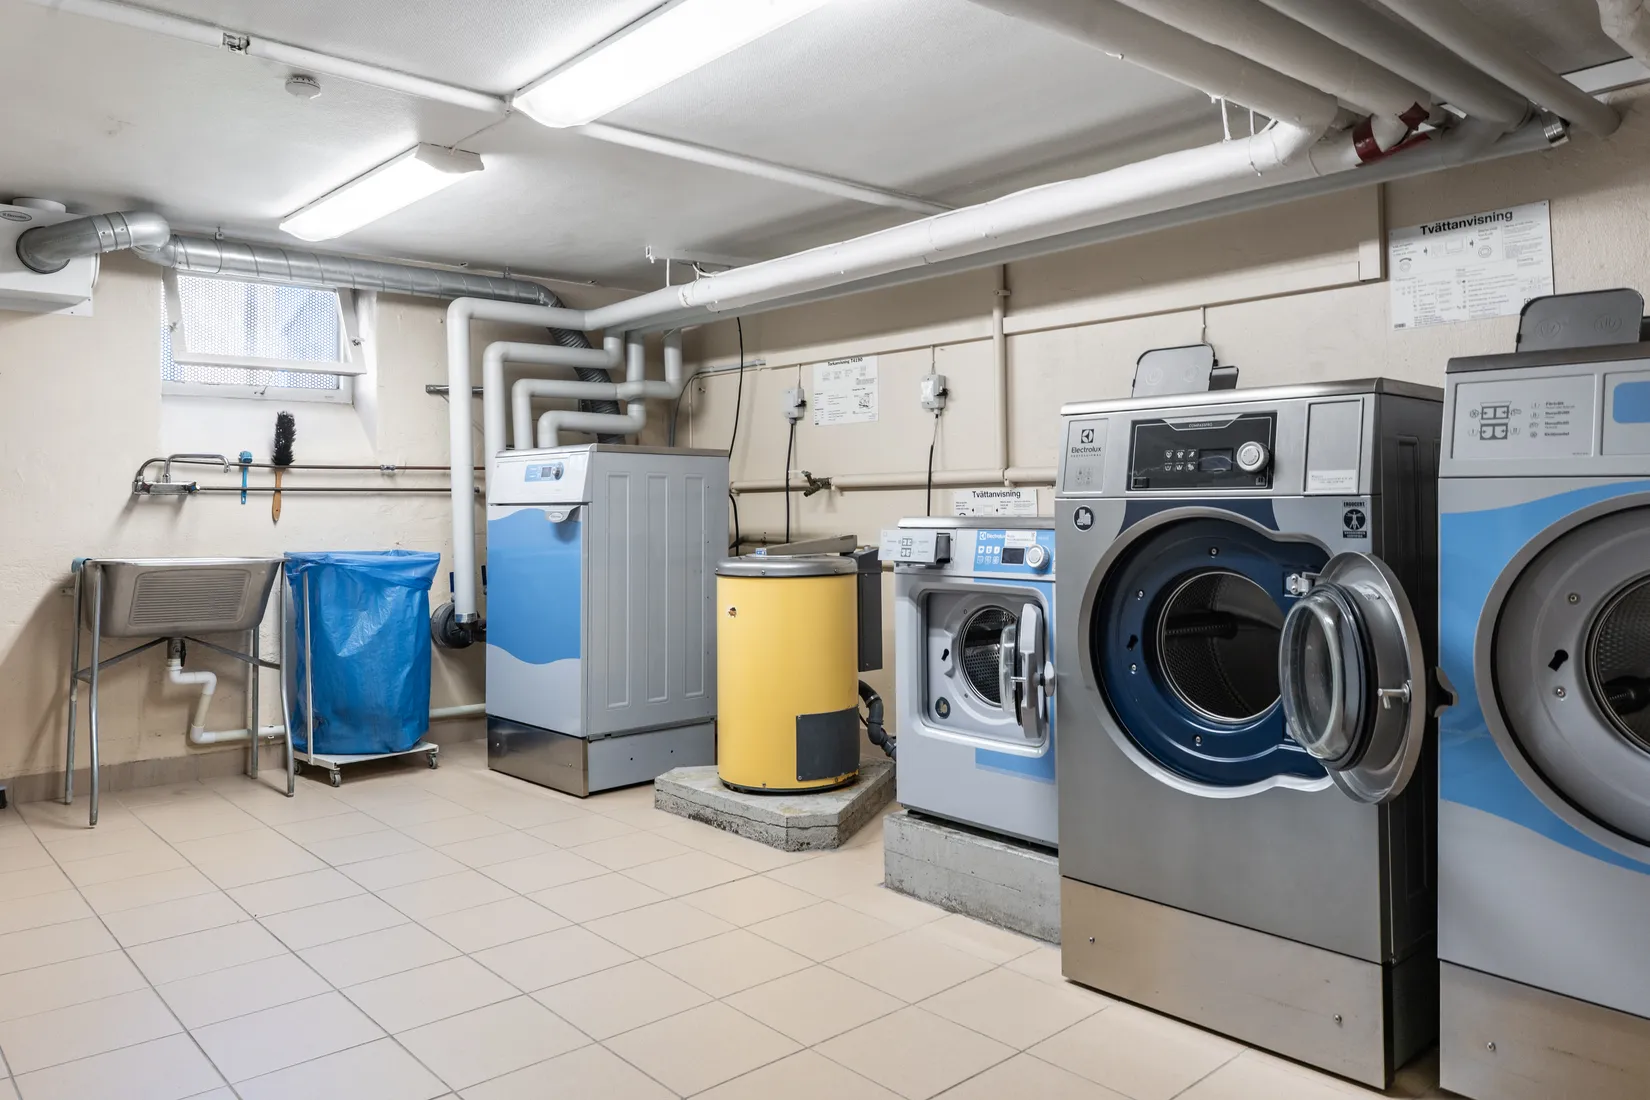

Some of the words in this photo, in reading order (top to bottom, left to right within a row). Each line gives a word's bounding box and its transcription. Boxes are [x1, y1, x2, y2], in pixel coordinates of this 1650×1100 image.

[1420, 211, 1513, 235] Tvättanvisning
[1071, 445, 1102, 454] Electrolux
[972, 490, 1021, 499] Tvättanvisning
